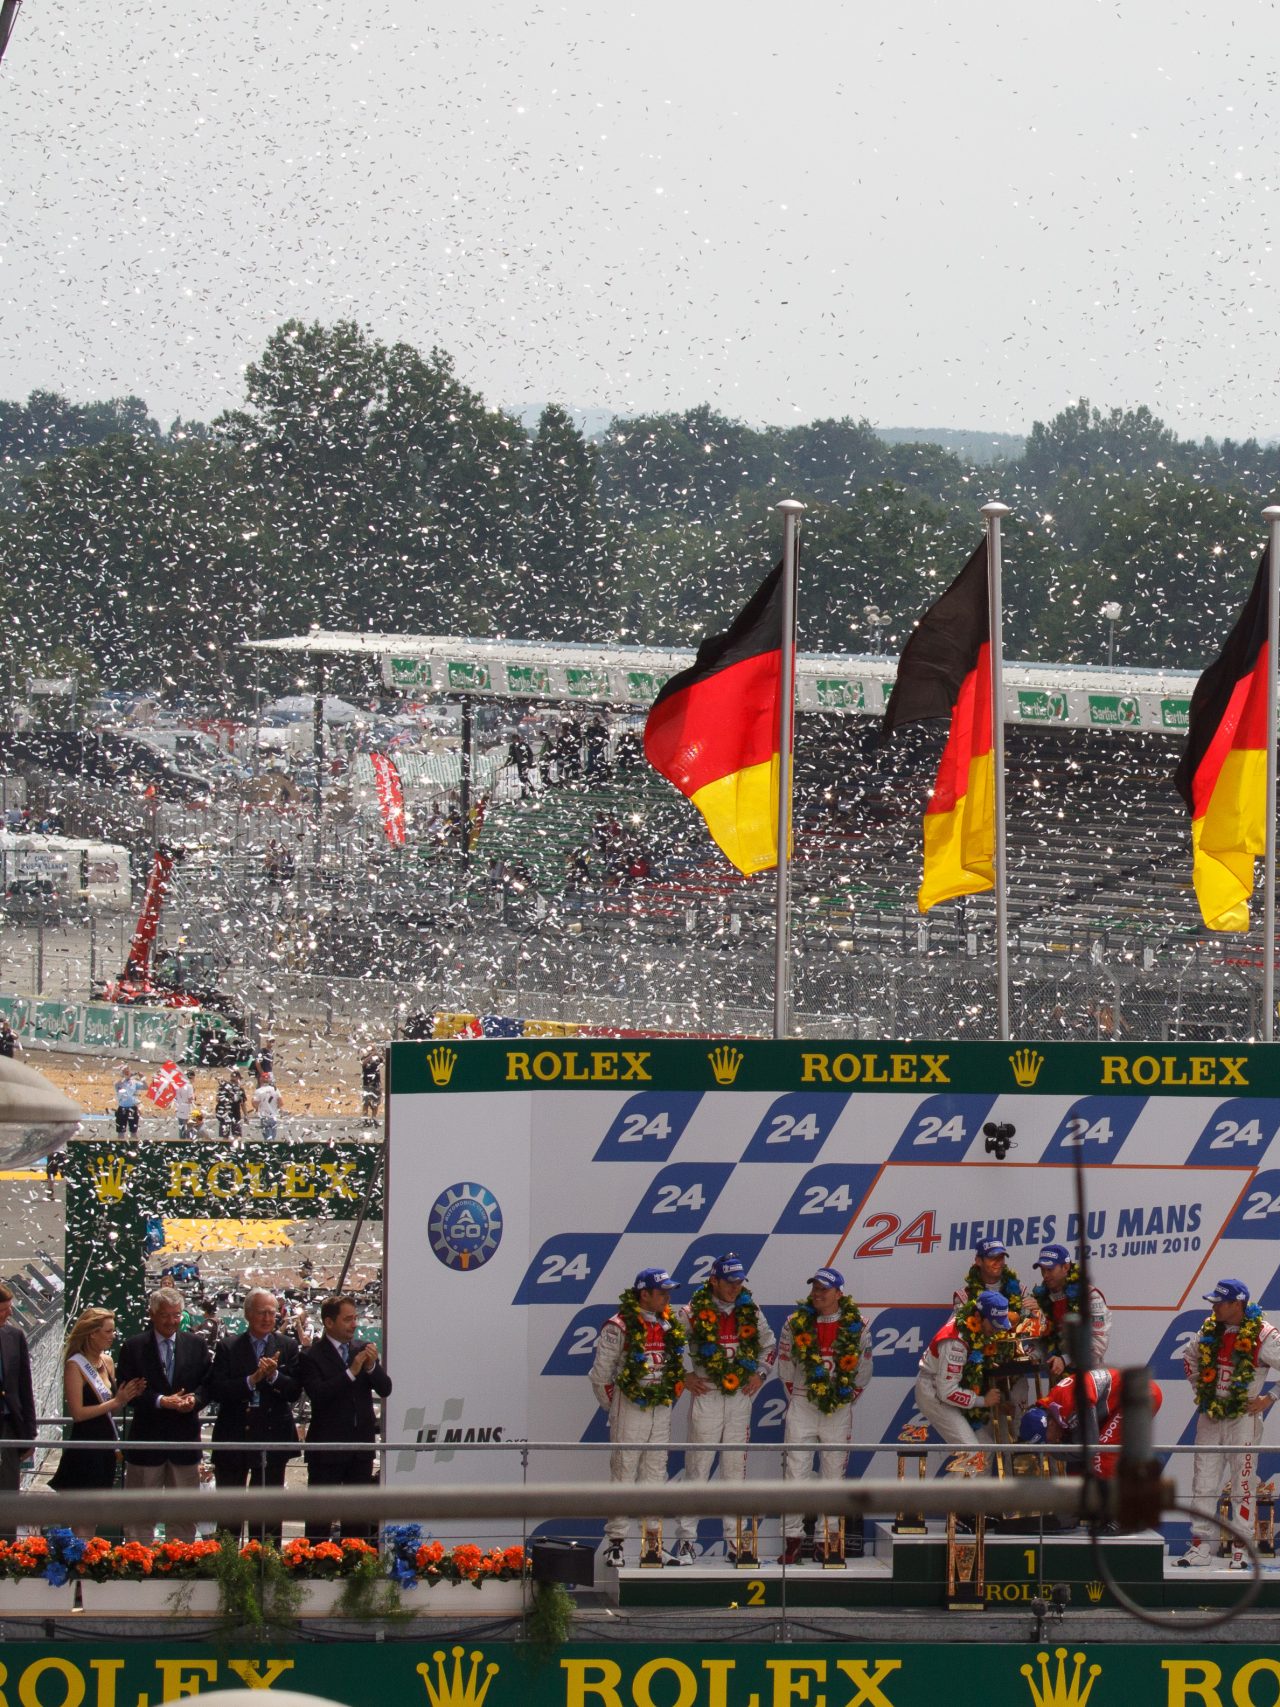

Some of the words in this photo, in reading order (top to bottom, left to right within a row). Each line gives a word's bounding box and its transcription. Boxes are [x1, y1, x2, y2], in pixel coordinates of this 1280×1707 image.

[1092, 705, 1117, 720] Sarthe
[505, 1052, 652, 1081] ROLEX
[801, 1053, 951, 1083] ROLEX
[1101, 1056, 1248, 1086] ROLEX
[618, 1112, 672, 1143] 24
[766, 1113, 820, 1144] 24
[913, 1115, 966, 1145] 24
[1060, 1117, 1114, 1147] 24
[1209, 1119, 1263, 1149] 24
[167, 1162, 358, 1199] ROLEX
[652, 1183, 706, 1214] 24
[799, 1184, 853, 1215] 24
[854, 1210, 941, 1259] 24
[950, 1214, 1056, 1251] HEURES
[1066, 1210, 1106, 1242] DU
[1117, 1203, 1202, 1237] MANS
[1122, 1240, 1159, 1258] JUIN
[1162, 1236, 1200, 1254] 2010
[536, 1253, 591, 1284] 24
[872, 1327, 923, 1357] 24
[952, 1393, 972, 1407] TDI
[1242, 1481, 1251, 1505] Audi
[1024, 1550, 1036, 1574] 1
[747, 1580, 766, 1605] 2
[560, 1658, 902, 1707] ROLEX
